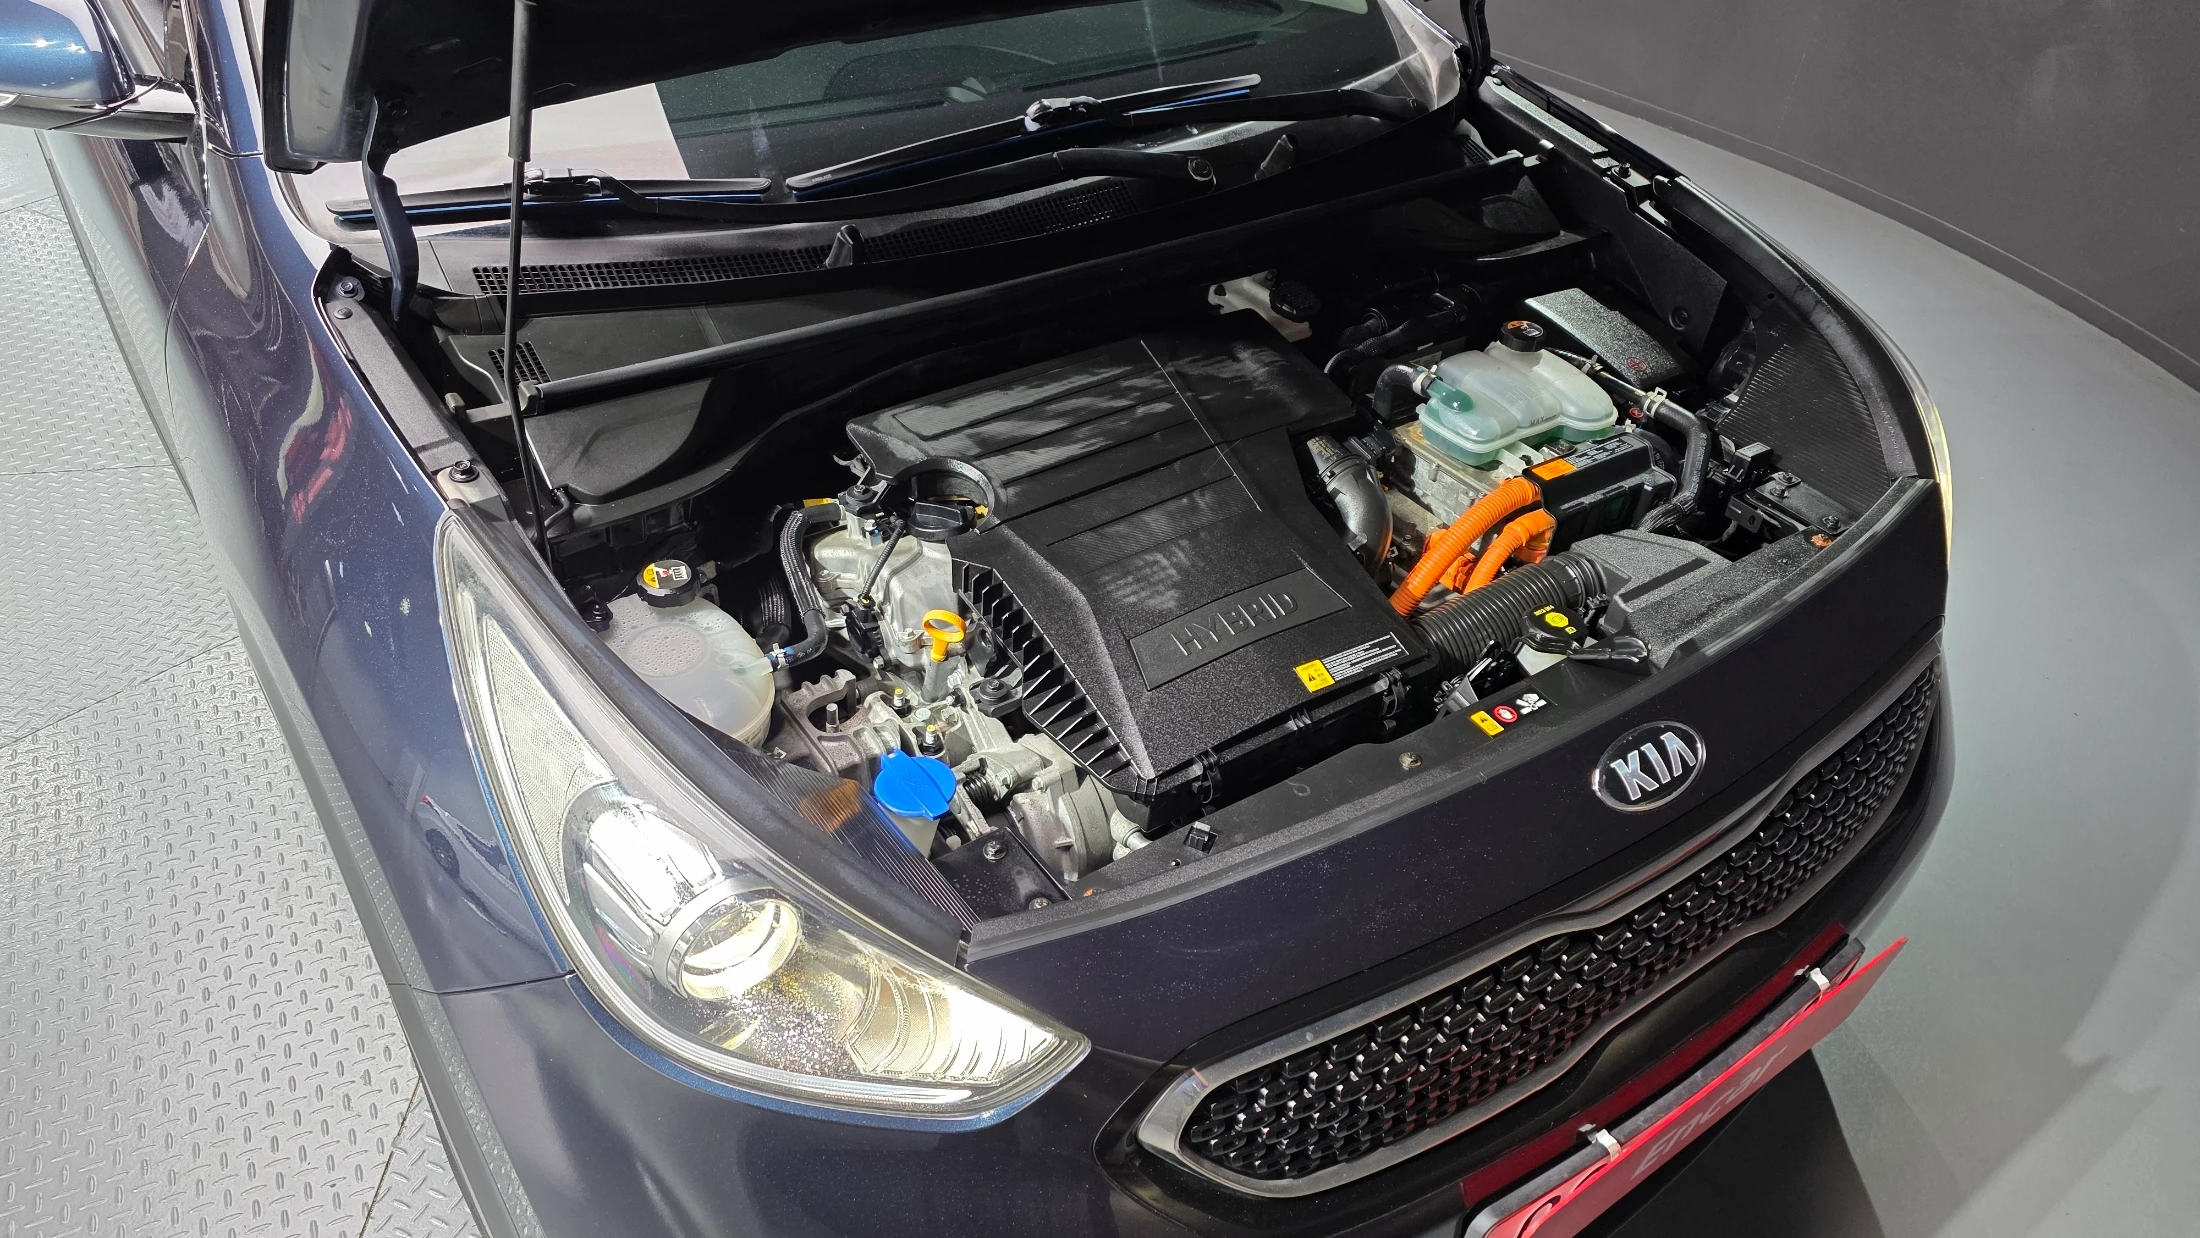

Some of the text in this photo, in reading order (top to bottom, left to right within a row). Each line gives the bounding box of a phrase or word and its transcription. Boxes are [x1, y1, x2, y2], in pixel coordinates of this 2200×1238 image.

[1529, 415, 1545, 428] MAX
[1170, 593, 1299, 656] HYBRID
[1609, 731, 1697, 801] KIA
[1630, 1045, 1788, 1181] Encar
